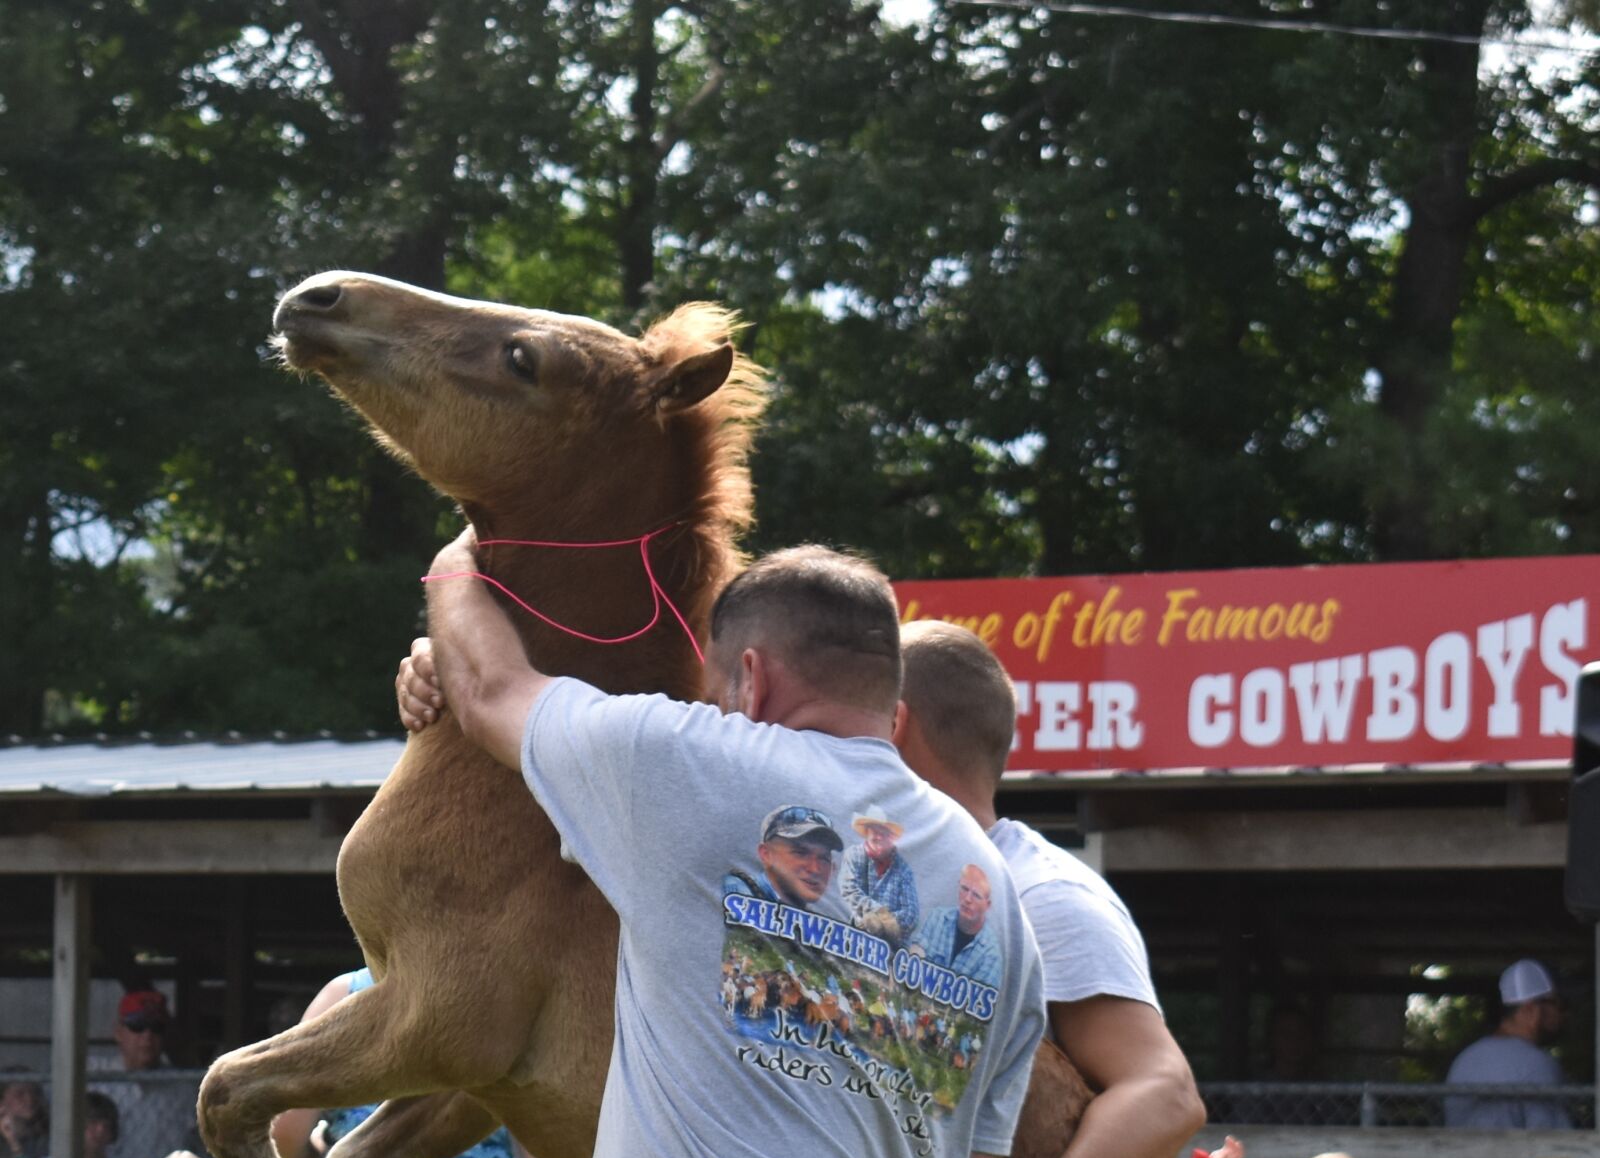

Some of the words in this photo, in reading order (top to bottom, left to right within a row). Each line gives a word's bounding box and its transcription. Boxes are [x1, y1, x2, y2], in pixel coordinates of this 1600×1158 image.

[1012, 588, 1075, 664] of
[1072, 584, 1147, 649] the
[1155, 587, 1342, 648] Famous
[1187, 597, 1588, 748] COWBOYS
[724, 892, 891, 976] SALTWATER
[892, 947, 1000, 1022] COWBOYS
[737, 1042, 832, 1087] riders
[841, 1065, 881, 1099] in
[769, 1007, 810, 1047] In
[817, 1022, 887, 1082] hoor
